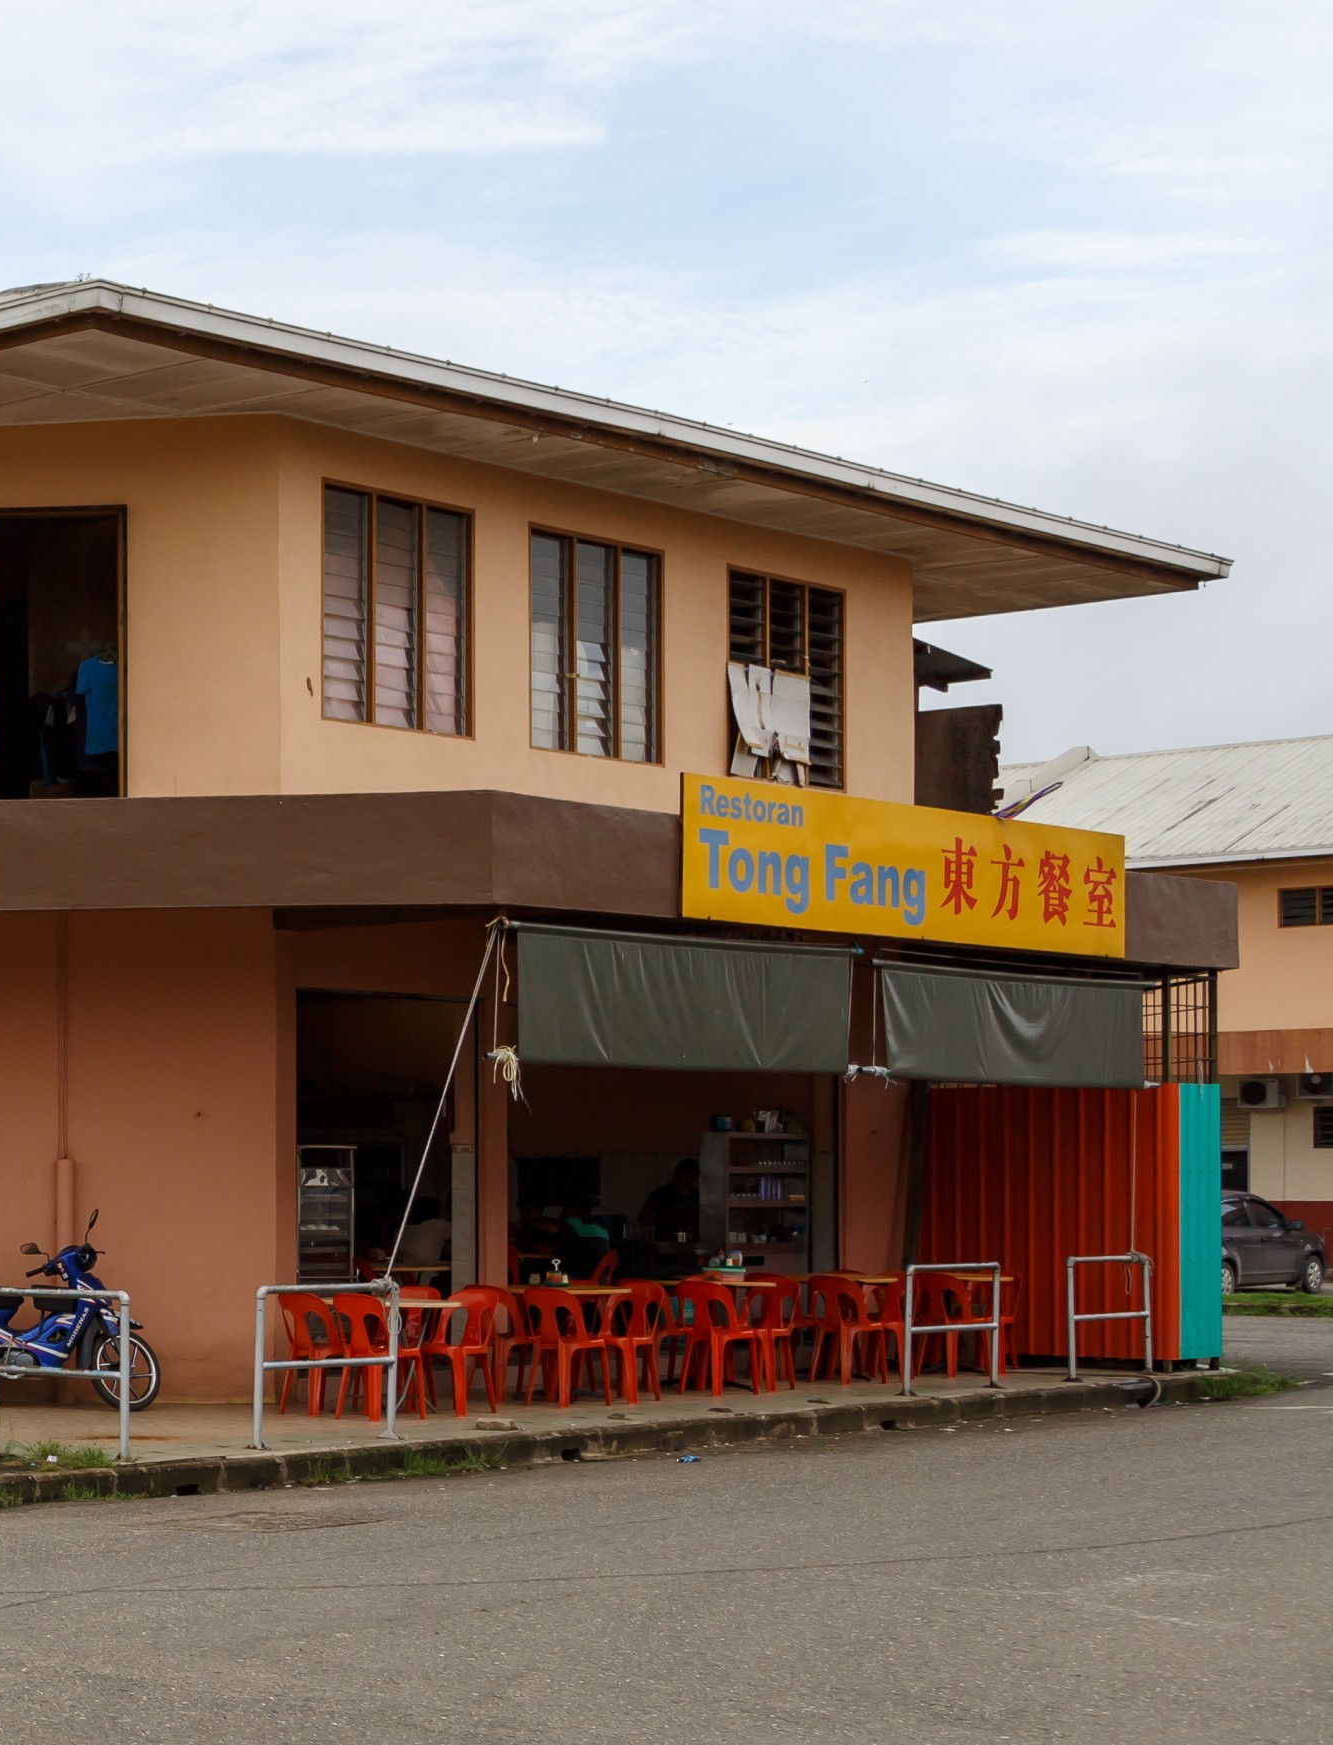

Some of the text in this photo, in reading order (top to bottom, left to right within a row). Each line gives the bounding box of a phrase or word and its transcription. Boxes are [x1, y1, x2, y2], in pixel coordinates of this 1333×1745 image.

[699, 783, 804, 828] Restoran
[698, 827, 926, 927] Tong Fang
[939, 835, 1118, 929] 東方餐室
[66, 1307, 90, 1348] MODENAS
